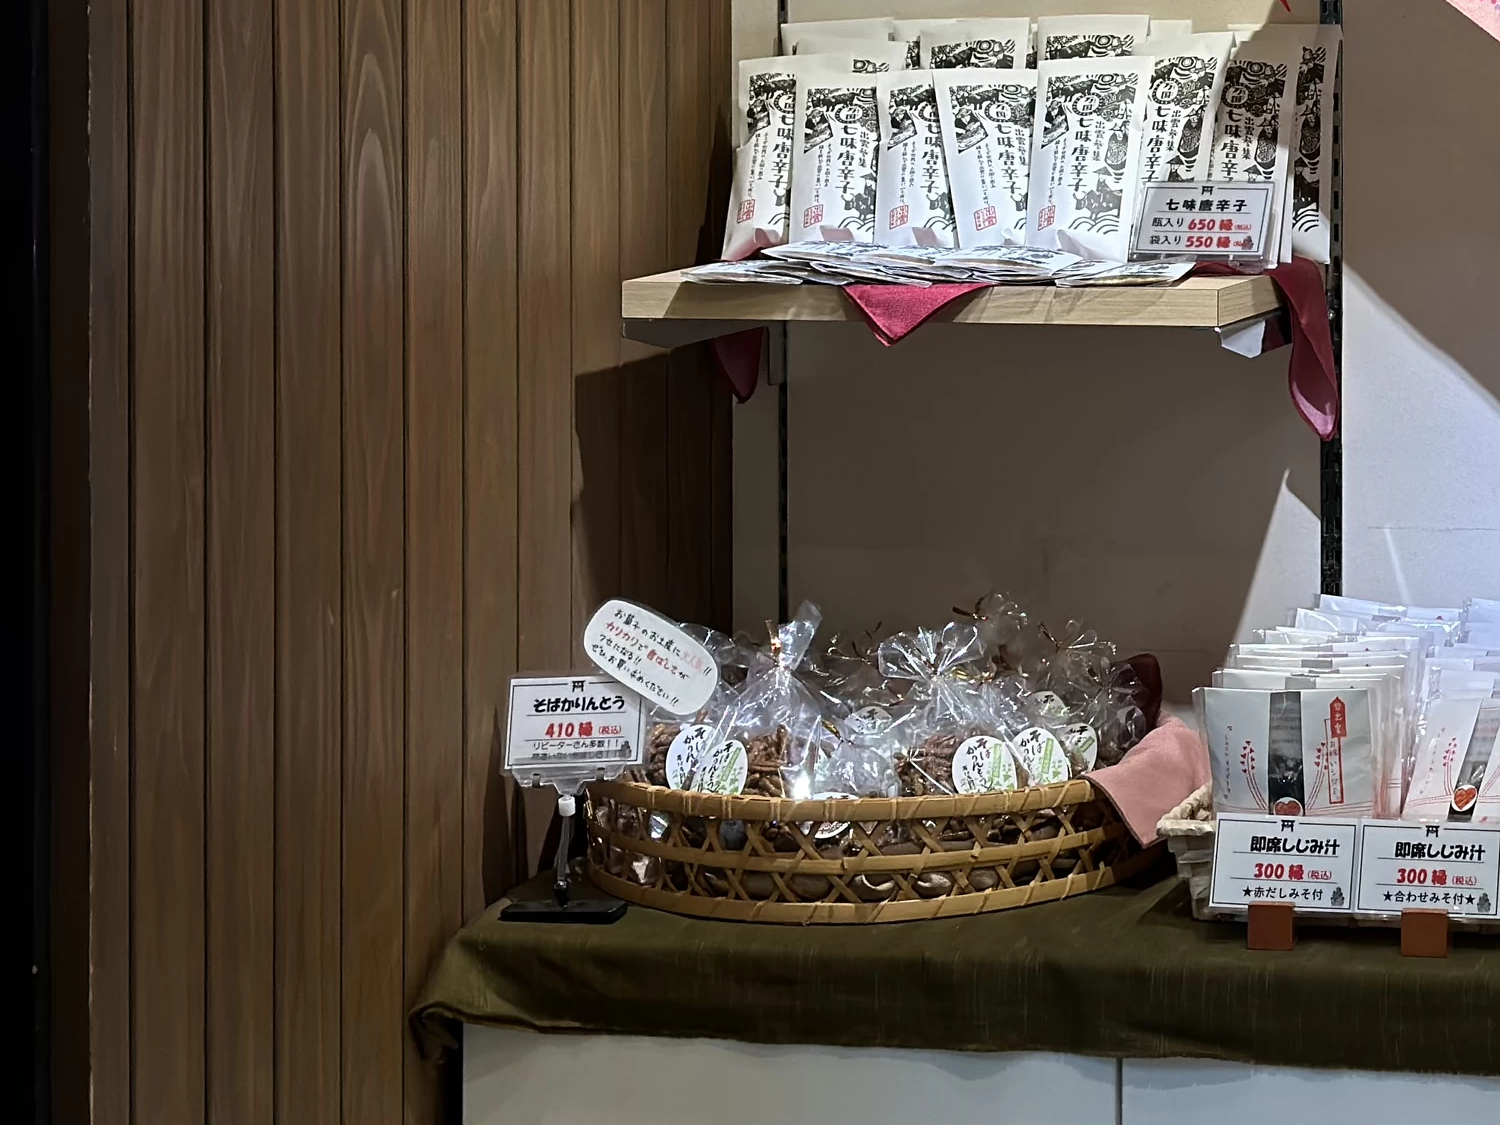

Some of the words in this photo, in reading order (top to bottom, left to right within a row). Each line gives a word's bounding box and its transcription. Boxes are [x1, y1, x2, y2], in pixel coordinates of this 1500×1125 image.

[835, 125, 859, 195] 七味唐辛子
[995, 124, 1021, 195] 七味唐辛子
[1067, 117, 1094, 193] 七味唐辛子
[1166, 198, 1247, 211] 七味唐辛子
[1187, 219, 1215, 231] 650
[1185, 236, 1213, 248] 550
[533, 695, 625, 713] そばかりんとう
[545, 722, 574, 738] 410
[1250, 836, 1340, 856] 即席しじみ汁
[1394, 841, 1486, 861] 即席しじみ汁
[1254, 863, 1284, 879] 300
[1397, 868, 1428, 884] 300
